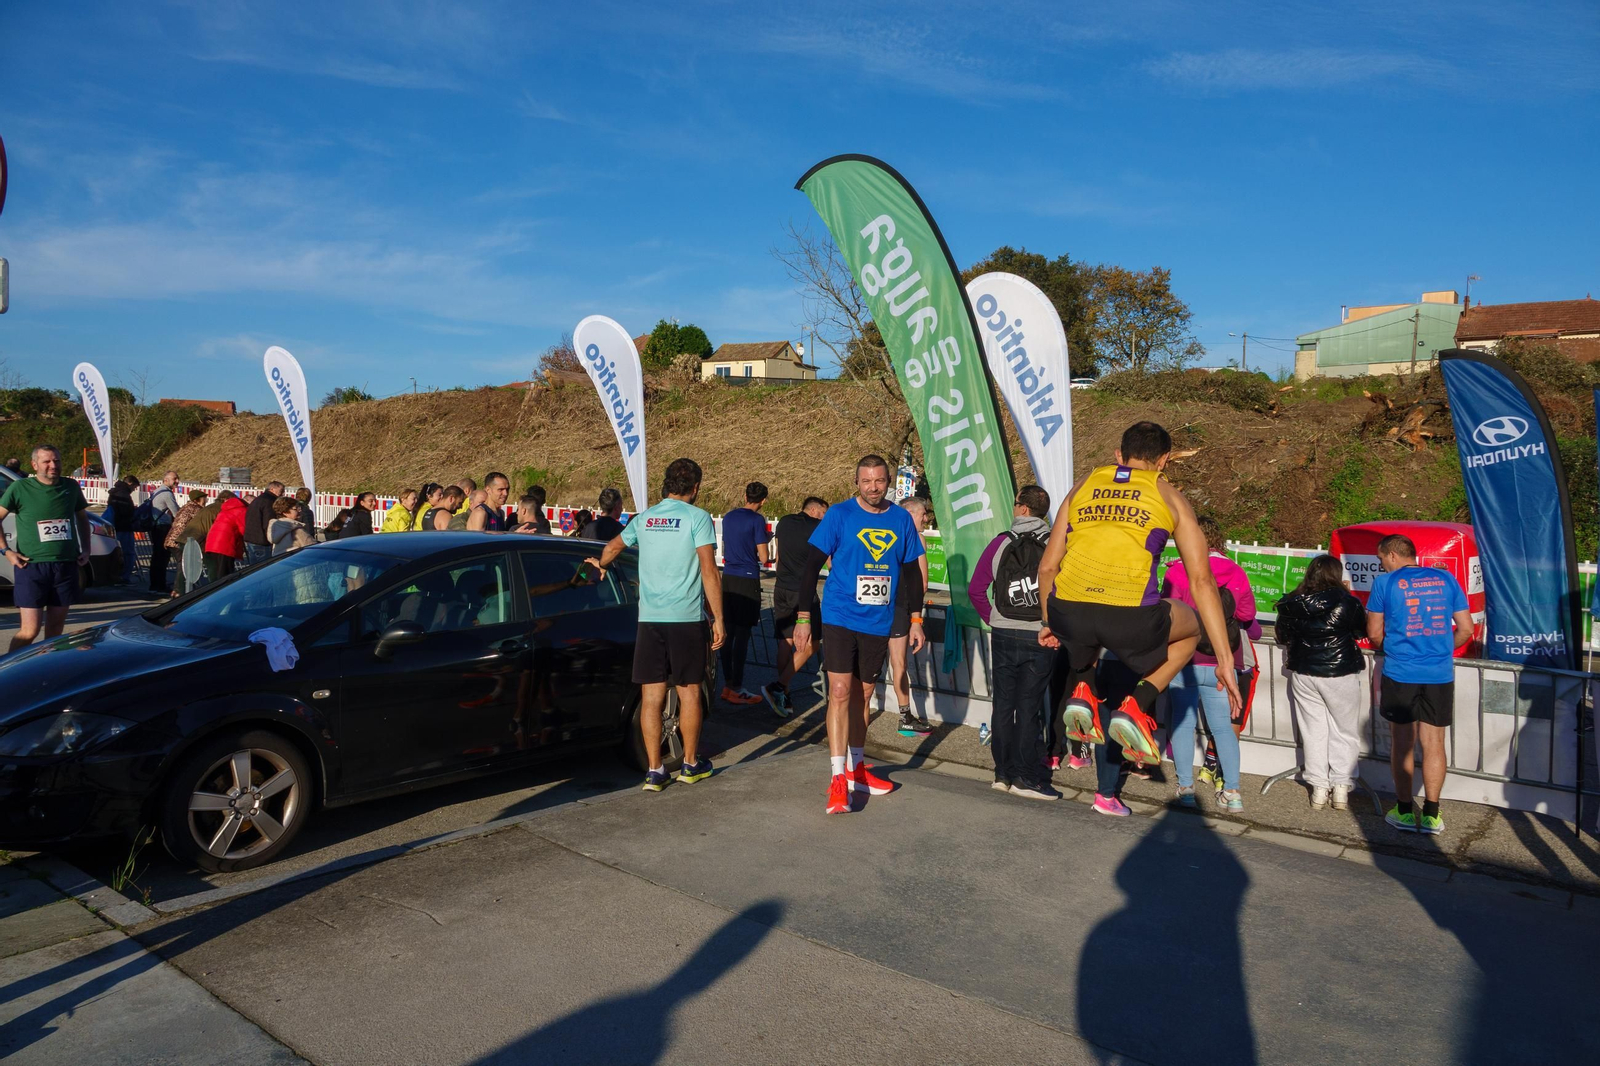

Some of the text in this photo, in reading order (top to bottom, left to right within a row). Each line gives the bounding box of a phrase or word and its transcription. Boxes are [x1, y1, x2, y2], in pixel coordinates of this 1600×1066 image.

[1092, 488, 1142, 501] ROBER
[1077, 505, 1152, 521] TANINOS
[646, 518, 682, 528] SERVI
[43, 525, 68, 535] 234
[1291, 566, 1306, 574] mái
[1345, 562, 1387, 573] CONCE
[1352, 574, 1367, 583] DE
[862, 584, 888, 597] 230
[1008, 575, 1039, 598] FIL
